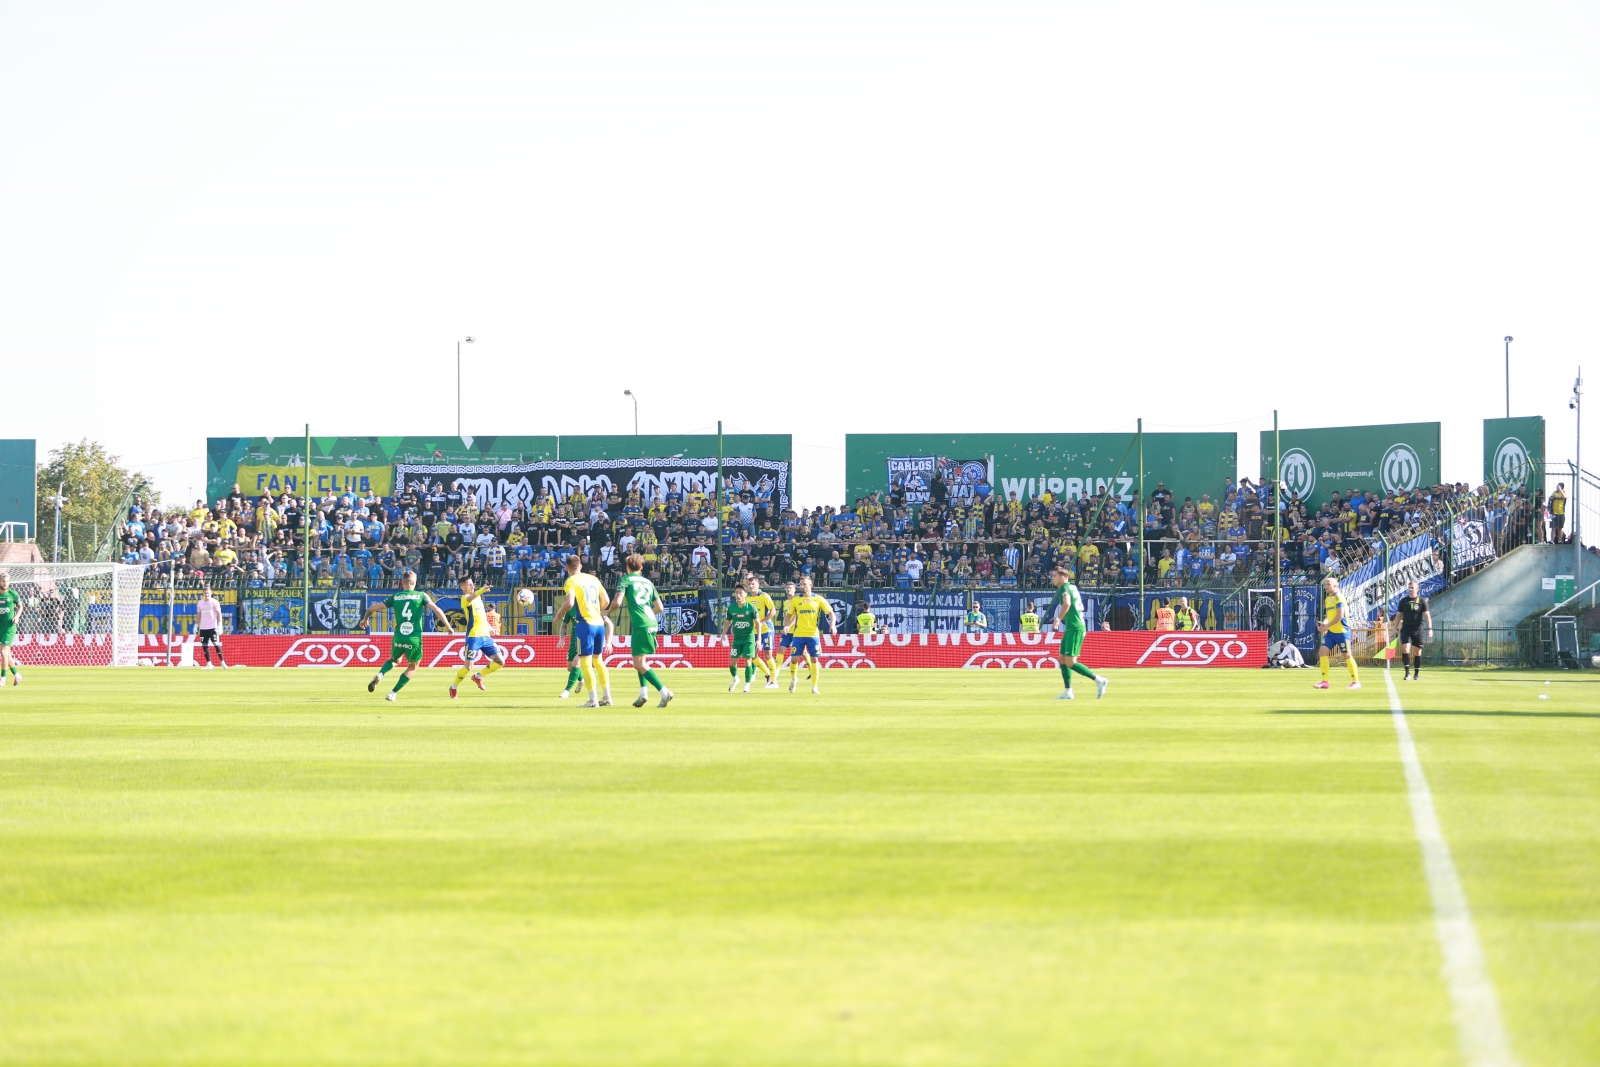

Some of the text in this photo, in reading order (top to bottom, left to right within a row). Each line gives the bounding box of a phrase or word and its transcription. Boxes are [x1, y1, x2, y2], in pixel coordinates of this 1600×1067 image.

[891, 461, 932, 471] CARLOS
[1322, 470, 1374, 480] bilety.wartapoznan.pl
[869, 592, 964, 607] LECH POZNAŃ
[401, 601, 413, 621] 4
